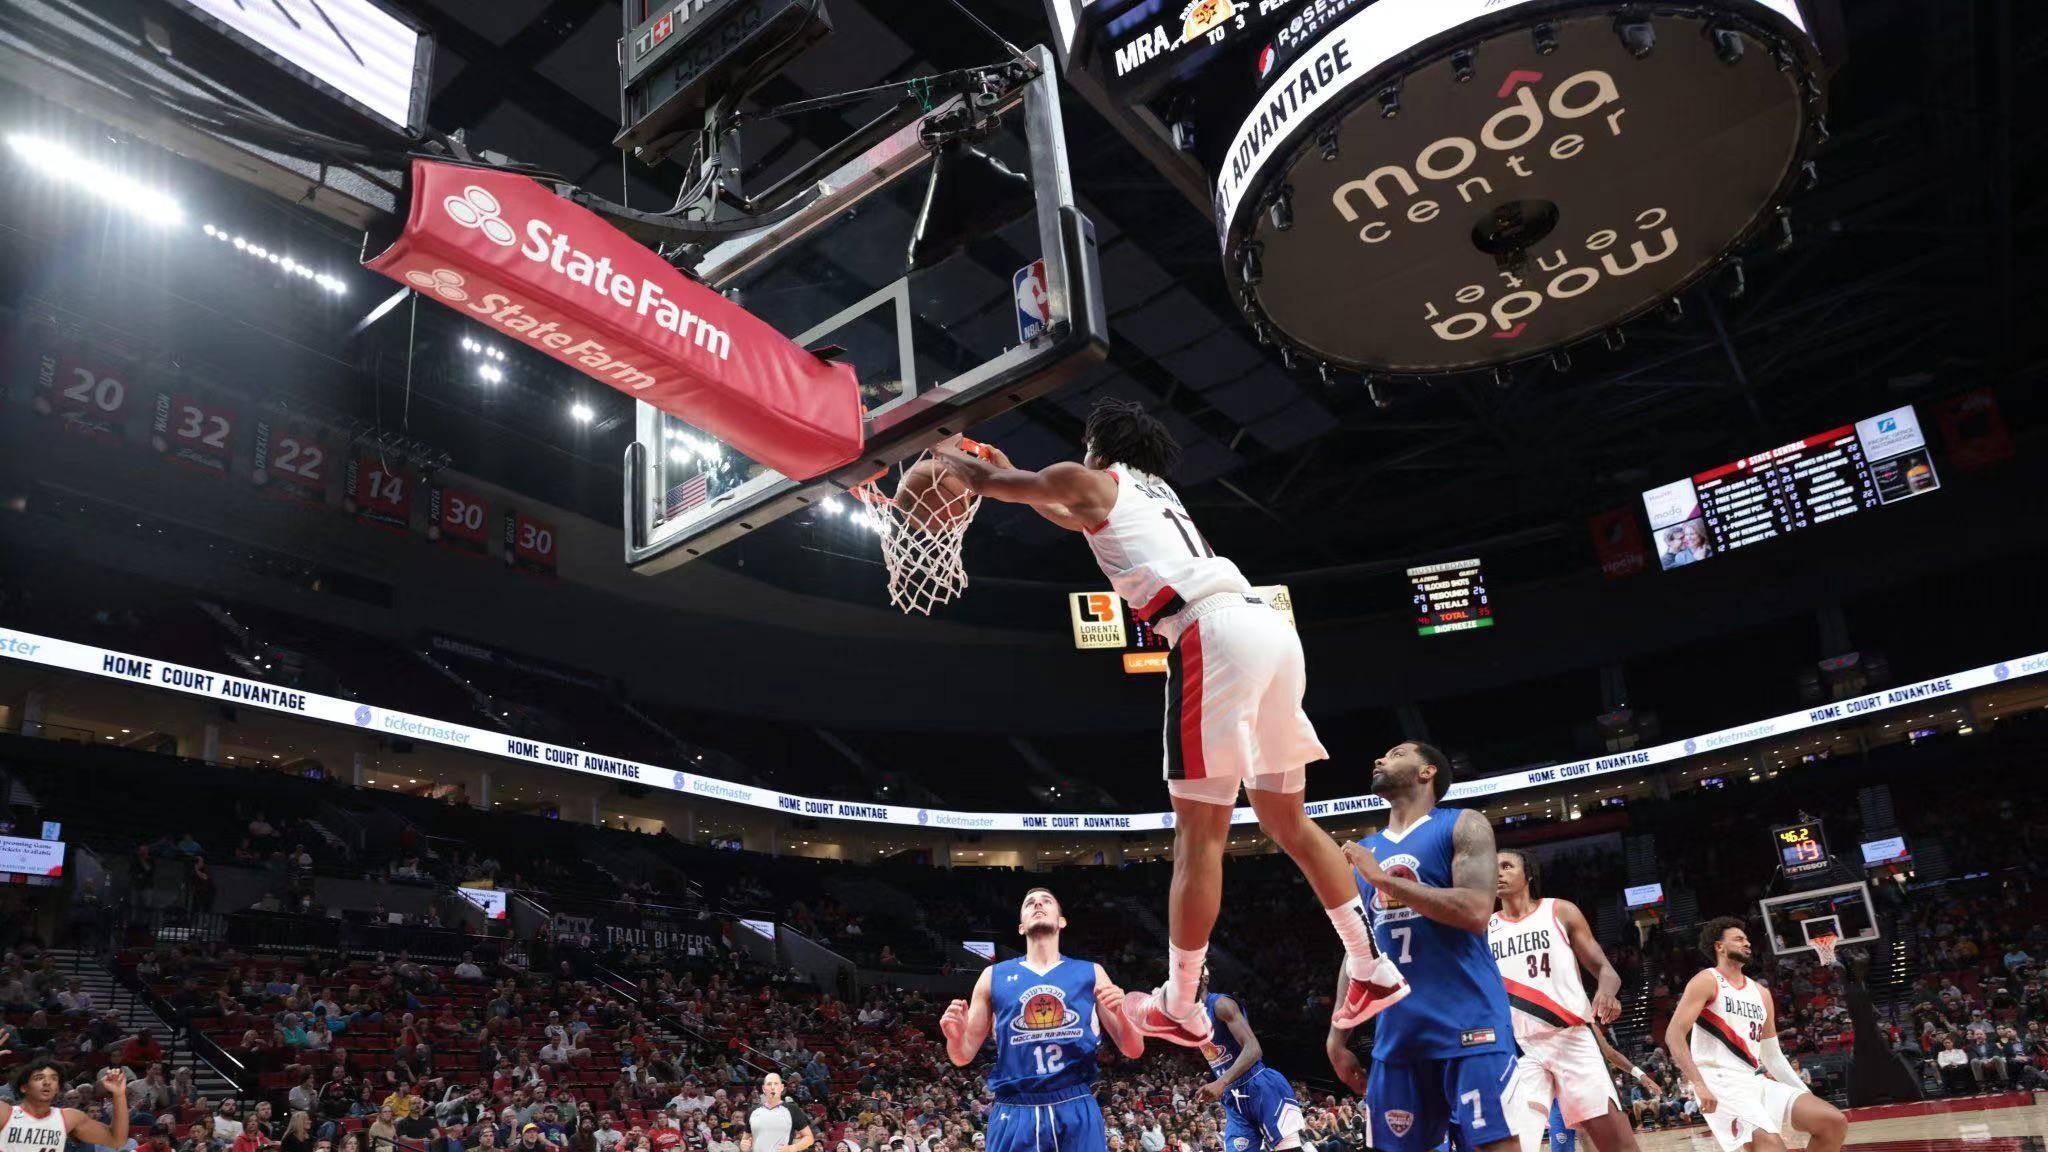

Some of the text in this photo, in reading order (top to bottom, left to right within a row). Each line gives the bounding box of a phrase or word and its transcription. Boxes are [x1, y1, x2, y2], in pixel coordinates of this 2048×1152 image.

[1206, 14, 1246, 45] TO 3
[1115, 25, 1171, 77] MRA
[1232, 39, 1353, 188] ADVANTAGE
[1333, 70, 1620, 222] moda
[1359, 108, 1625, 243] center
[1425, 207, 1667, 322] center
[1430, 227, 1679, 341] moda
[1024, 322, 1040, 340] NBA
[64, 368, 125, 412] 20
[153, 392, 171, 433] WALTON
[178, 406, 231, 449] 32
[275, 438, 325, 481] 22
[1749, 440, 1807, 465] STATS CENTRAL
[369, 471, 404, 505] 14
[431, 487, 442, 522] PORTER
[446, 498, 484, 531] 30
[520, 523, 553, 555] 30
[1161, 508, 1216, 558] 17
[1408, 560, 1480, 576] HUSTLEBOARD
[1412, 575, 1439, 584] BLAZERS
[1458, 569, 1478, 577] GUEST
[1414, 594, 1426, 604] 29
[1424, 578, 1470, 591] BLOCKED SHOTS
[1430, 588, 1470, 601] REBOUNDS
[1434, 599, 1469, 610] STEALS
[1440, 611, 1469, 621] TOTAL
[1080, 625, 1119, 634] LORENTZ
[1081, 633, 1121, 643] BRUUN
[1434, 620, 1478, 634] BIOFREEZE
[103, 654, 306, 711] HOME COURT ADVANTAGE
[1810, 679, 1953, 722] HOME COURT ADVANTAGE
[385, 714, 471, 745] ticketmaster
[1705, 723, 1776, 747] ticketmaster
[507, 739, 640, 779] HOME COURT ADVANTAGE
[1528, 752, 1650, 784] HOME COURT ADVANTAGE
[692, 779, 752, 802] ticketmaster
[1333, 797, 1384, 812] ADVANTAGE
[779, 795, 888, 820] HOME COURT ADVANTAGE
[936, 813, 994, 827] ticketmaster
[1022, 816, 1131, 828] HOME COURT ADVANTAGE
[1780, 828, 1809, 843] 46.2
[1796, 840, 1820, 860] 19
[606, 925, 649, 947] TRAIL
[654, 931, 716, 953] BLAZERS
[1391, 926, 1413, 964] 7
[1491, 929, 1551, 962] BLAZERS
[1526, 953, 1552, 979] 34
[1725, 996, 1764, 1021] BLAZERS
[1033, 1043, 1066, 1076] 12
[1460, 1088, 1486, 1130] 7
[7, 1126, 62, 1147] BLAZERS
